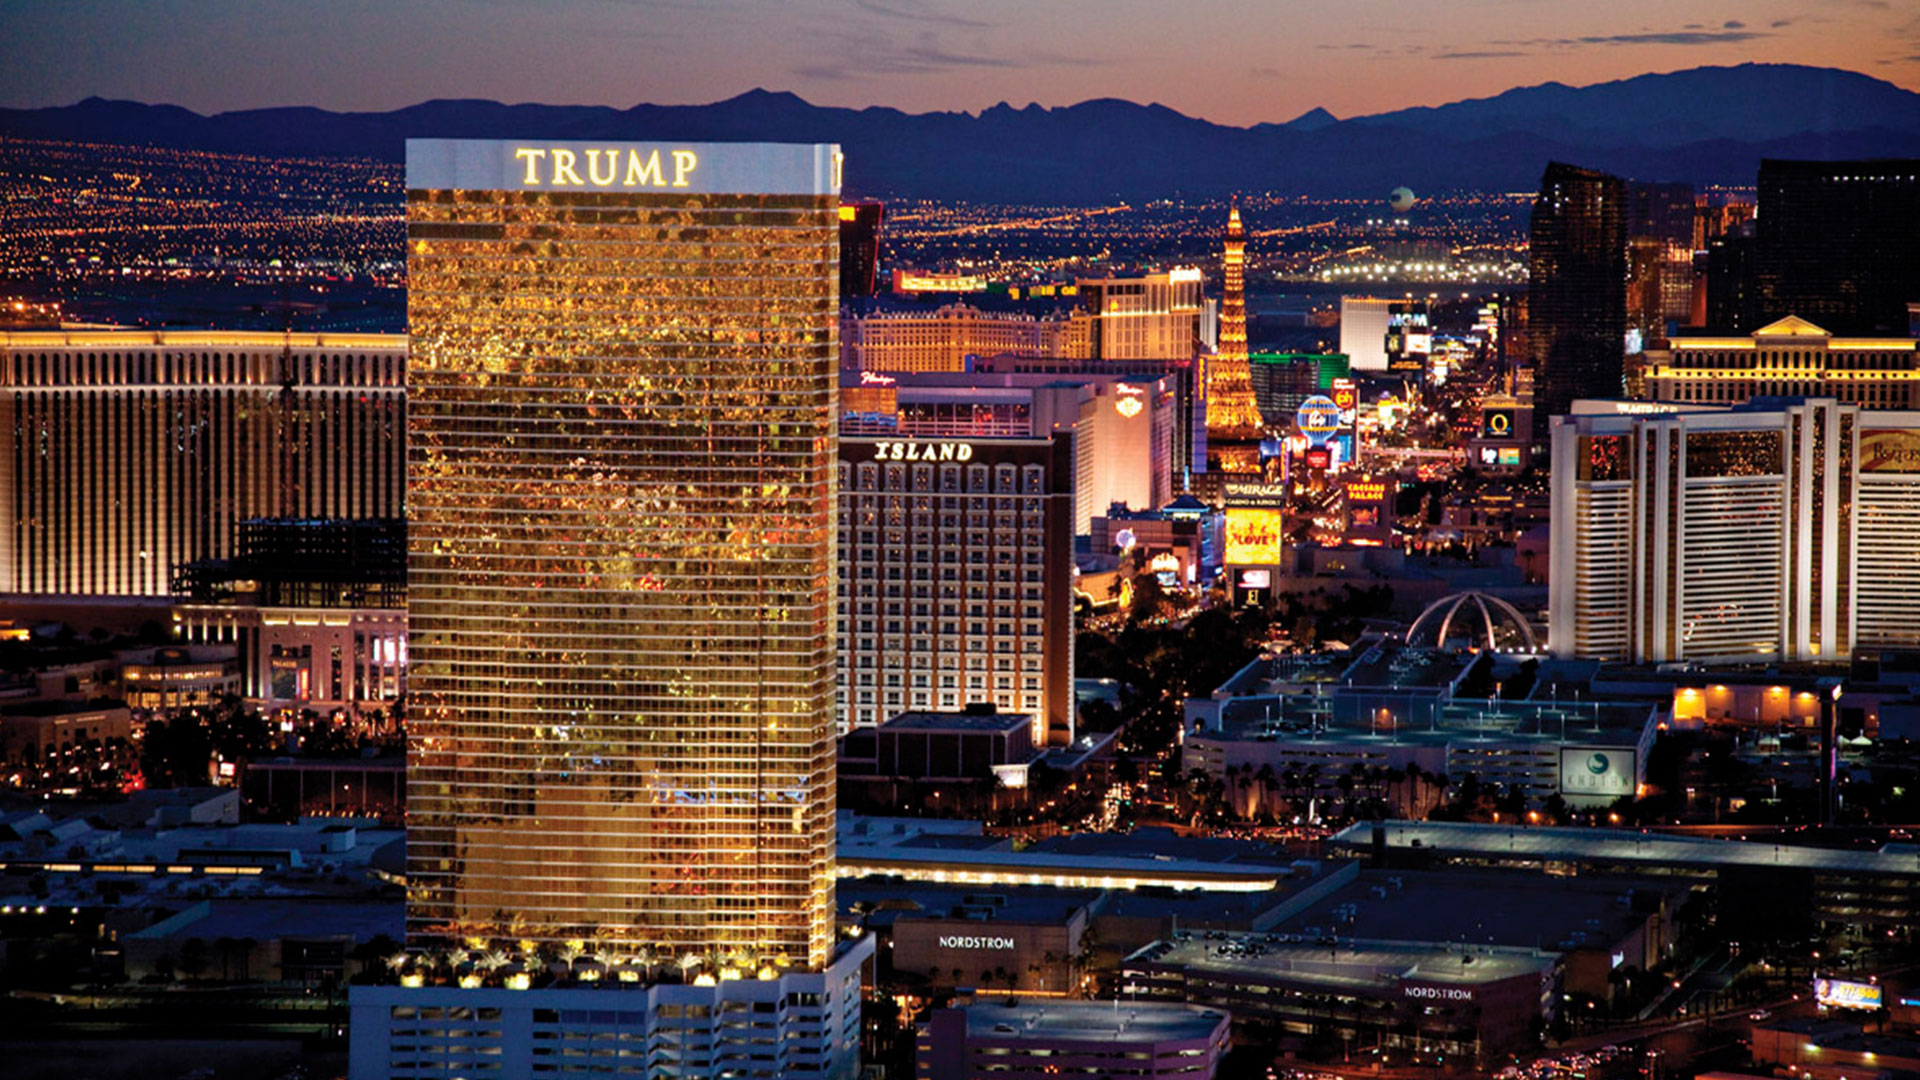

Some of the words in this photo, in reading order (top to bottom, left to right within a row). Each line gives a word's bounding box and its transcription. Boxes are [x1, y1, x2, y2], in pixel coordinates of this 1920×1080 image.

[515, 147, 698, 187] TRUMP
[1387, 313, 1428, 327] MGM
[874, 441, 973, 461] ISLAND
[1240, 484, 1283, 496] MIRAGE
[1347, 483, 1385, 491] CAESARS
[1349, 492, 1384, 500] PALACE
[1238, 535, 1269, 545] LOVE
[939, 936, 1015, 950] NORDSTROM
[1404, 987, 1473, 1001] NORDSTROM
